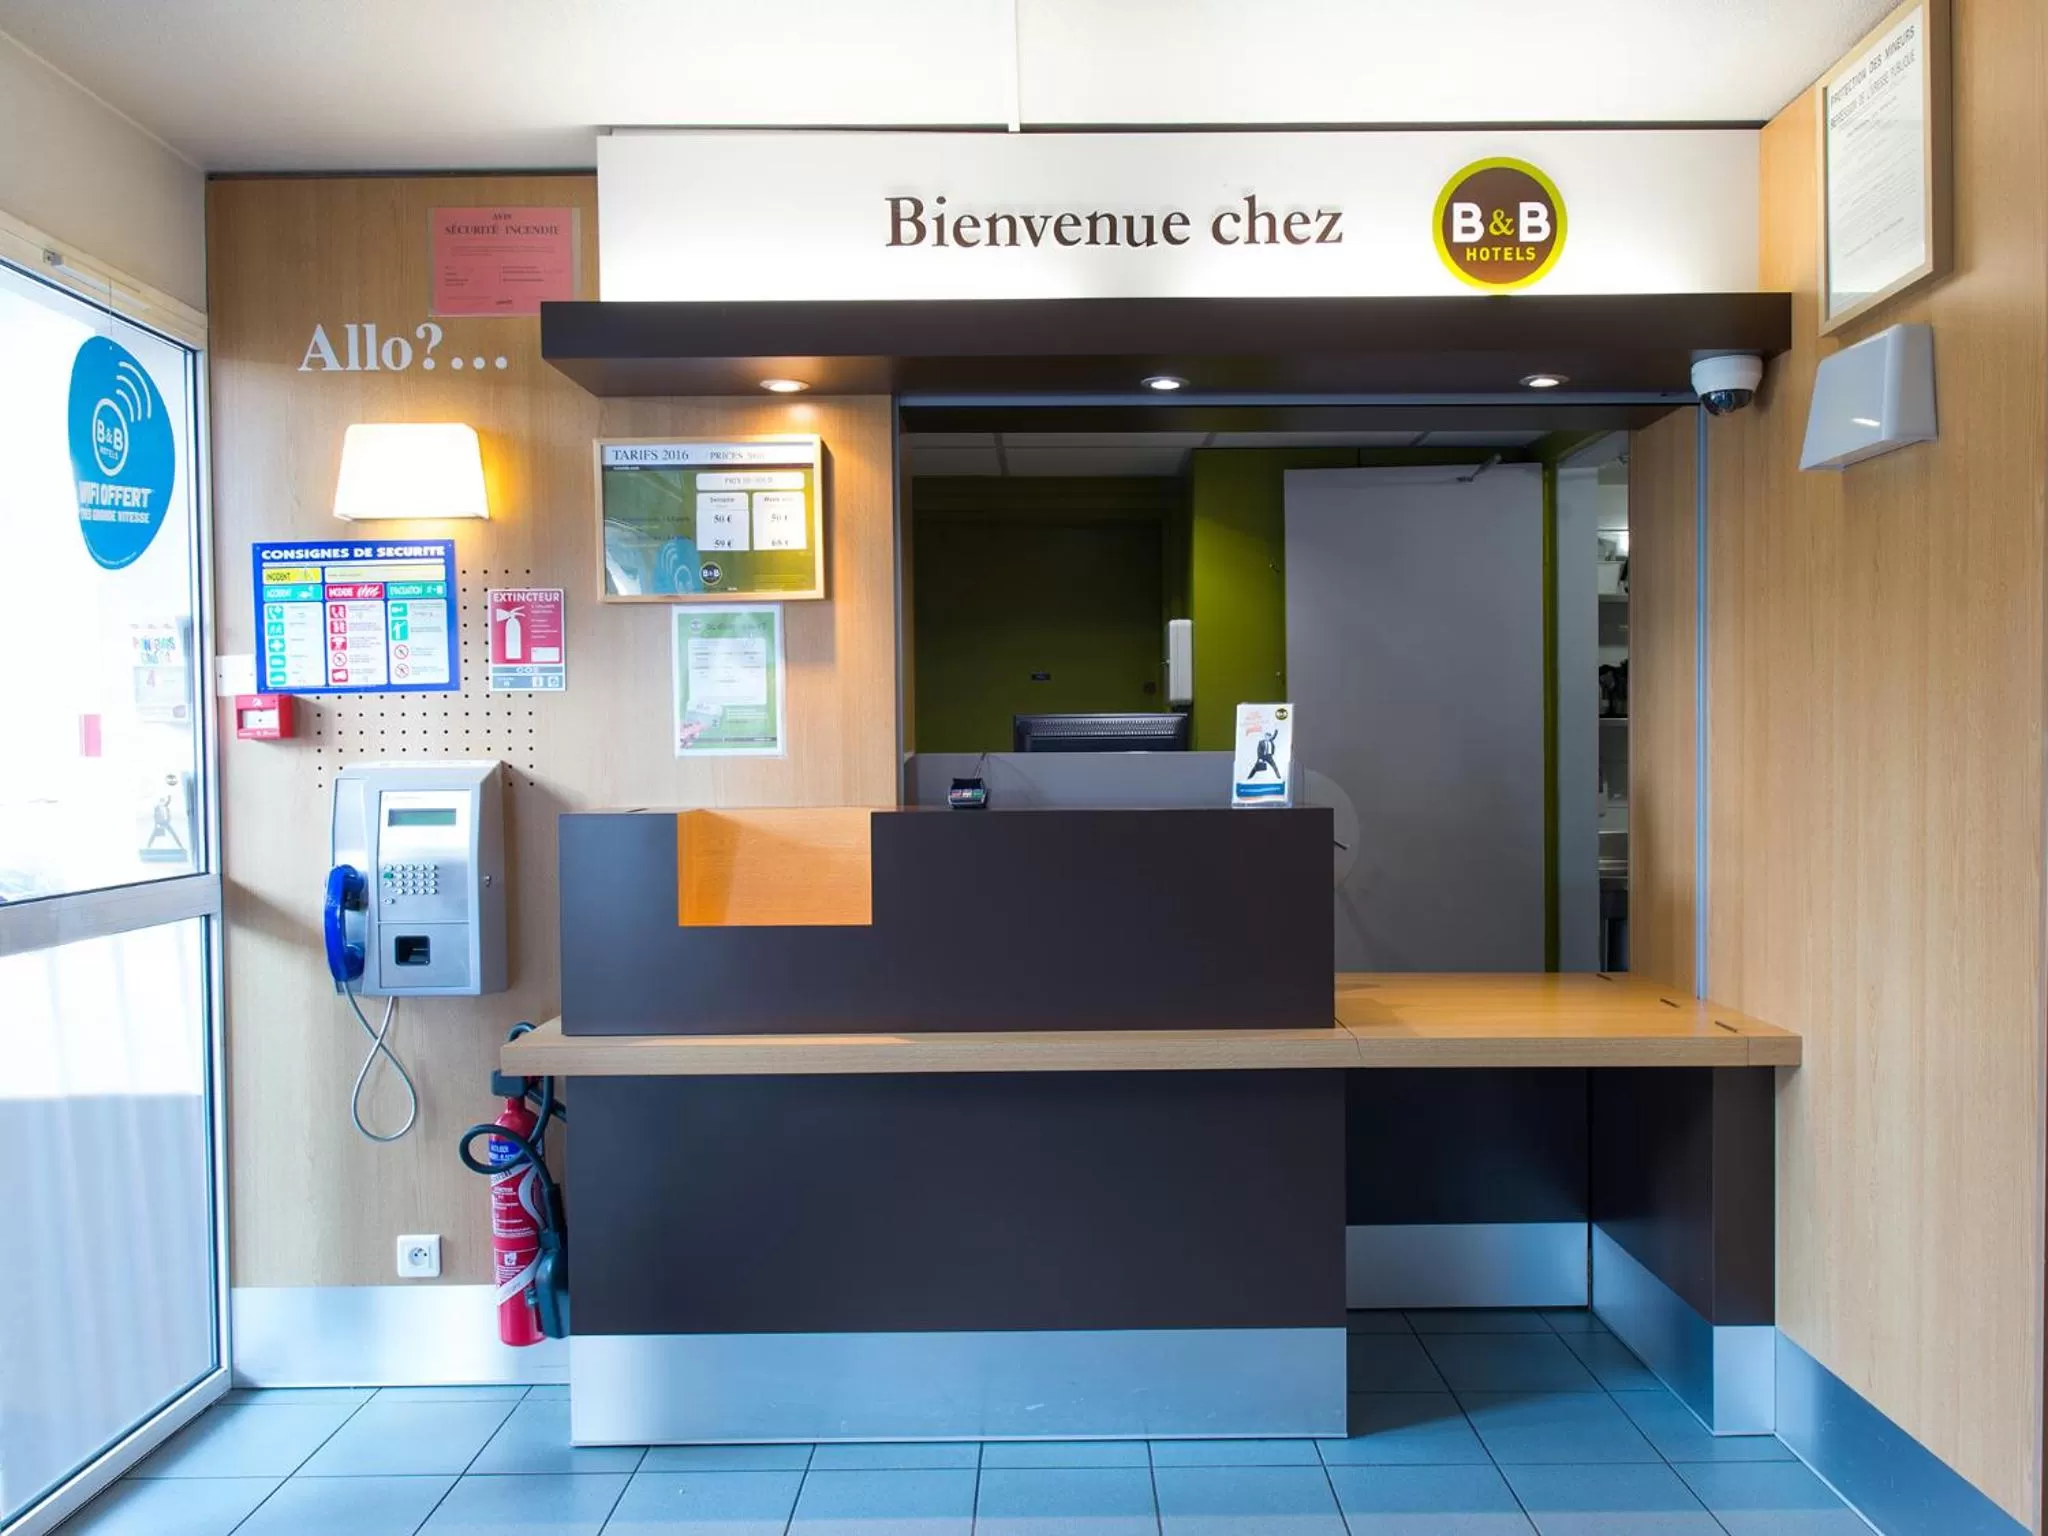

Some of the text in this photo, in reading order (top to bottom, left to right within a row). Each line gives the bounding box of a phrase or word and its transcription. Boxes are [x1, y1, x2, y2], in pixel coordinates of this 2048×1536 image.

[1868, 53, 1882, 74] DES
[505, 224, 559, 235] INCENDIE
[885, 194, 1344, 249] Bienvenue chez
[1452, 201, 1552, 243] B&B
[1466, 247, 1536, 262] HOTELS
[96, 419, 124, 451] B&B
[612, 450, 659, 461] TARIFS
[662, 449, 689, 461] 2016
[101, 483, 152, 508] OFFERT
[262, 545, 446, 560] CONSIGNES DE SECURITE
[493, 592, 560, 602] EXTINCTEUR
